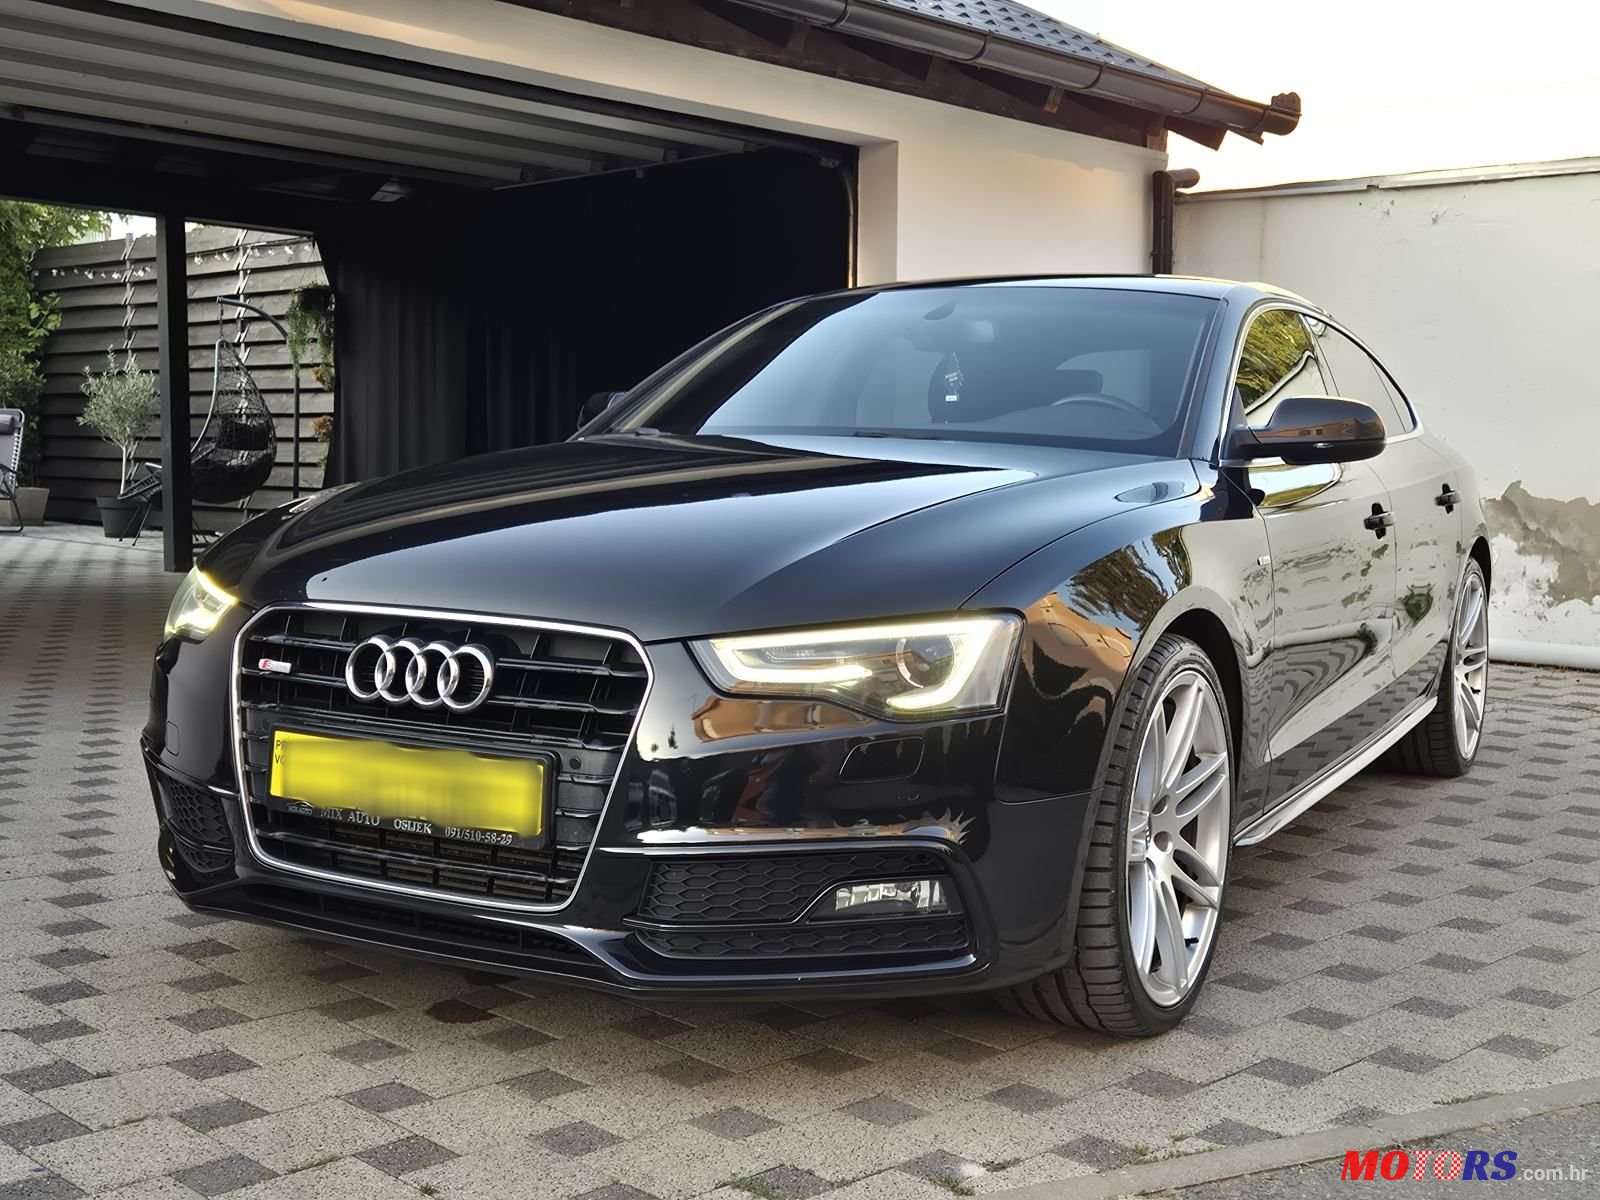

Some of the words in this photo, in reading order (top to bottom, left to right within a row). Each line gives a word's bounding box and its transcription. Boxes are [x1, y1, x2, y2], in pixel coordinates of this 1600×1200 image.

[320, 803, 343, 820] MIX
[393, 818, 432, 834] OSIJEK
[445, 826, 513, 846] 091/510-58-29
